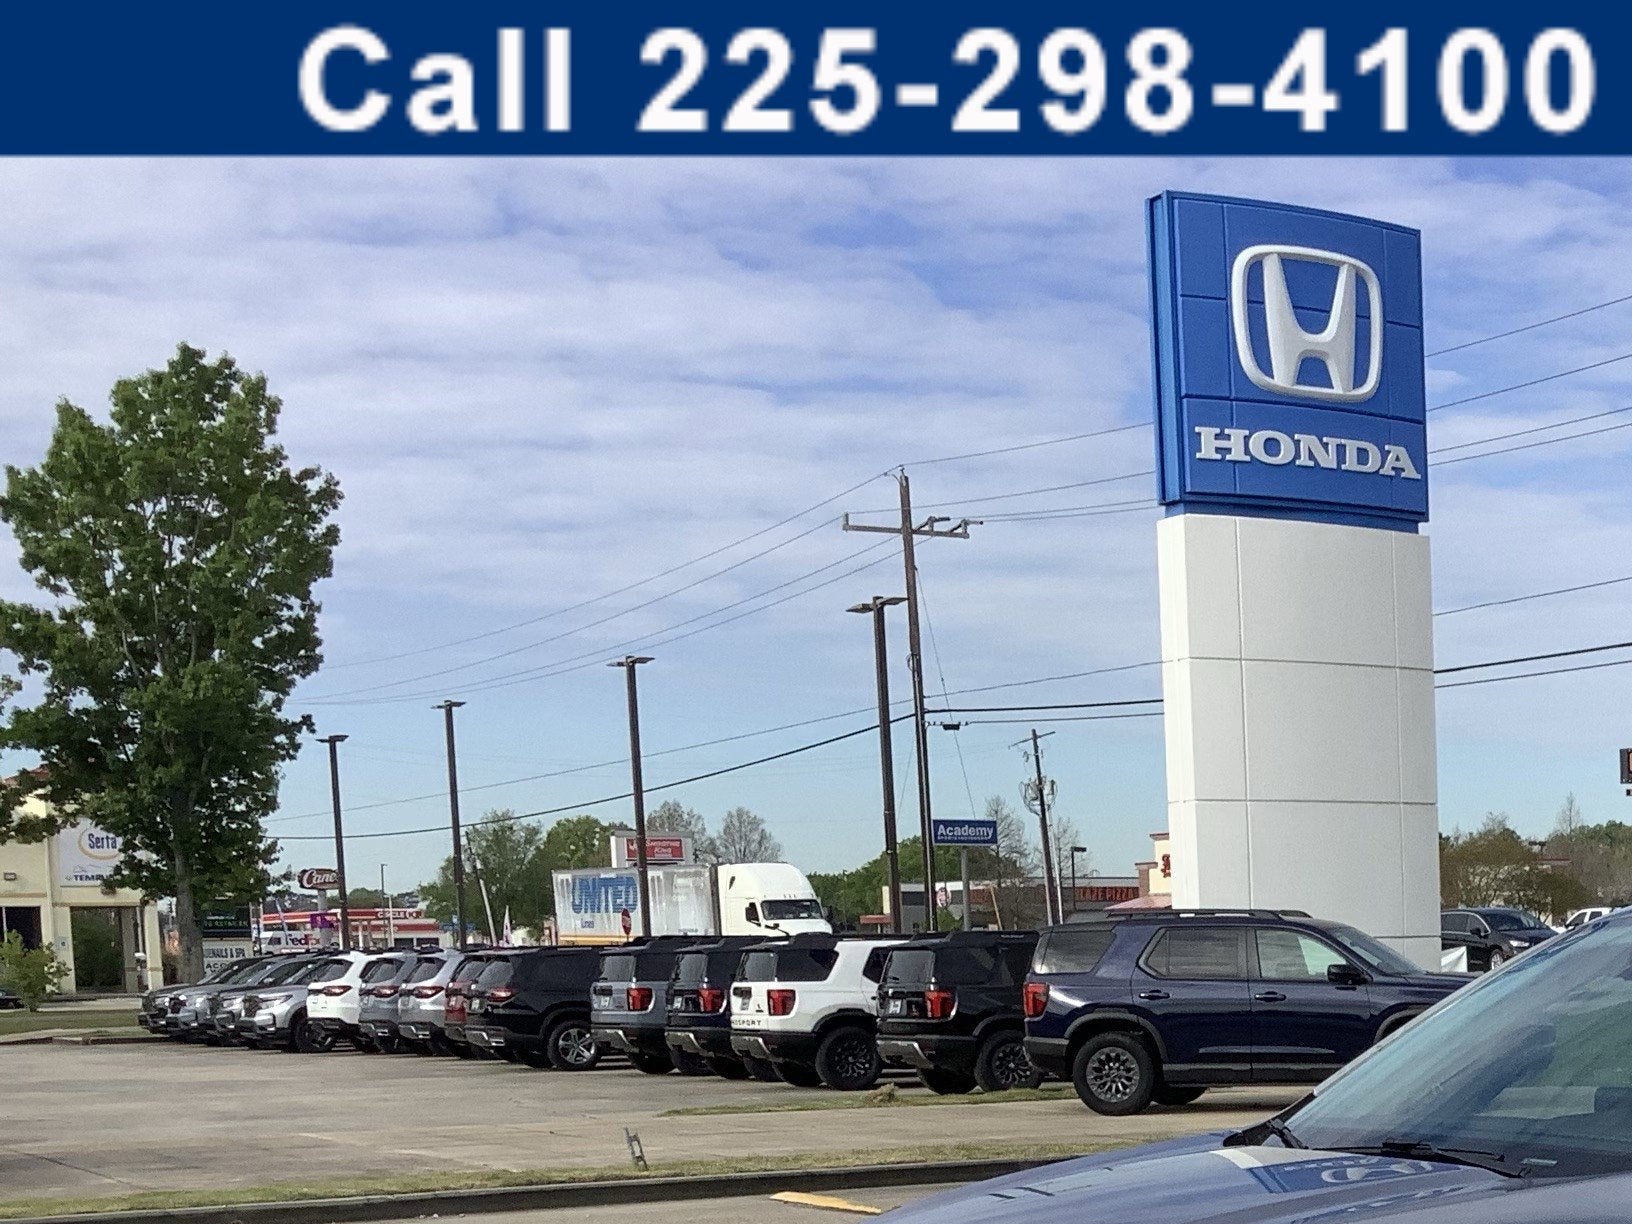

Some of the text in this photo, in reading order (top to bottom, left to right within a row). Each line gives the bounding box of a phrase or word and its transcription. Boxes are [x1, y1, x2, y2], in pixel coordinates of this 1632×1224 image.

[1195, 426, 1421, 480] HONDA
[87, 833, 117, 849] Serta
[937, 824, 993, 840] Academy
[302, 869, 338, 888] Cane
[572, 873, 639, 915] UNITED
